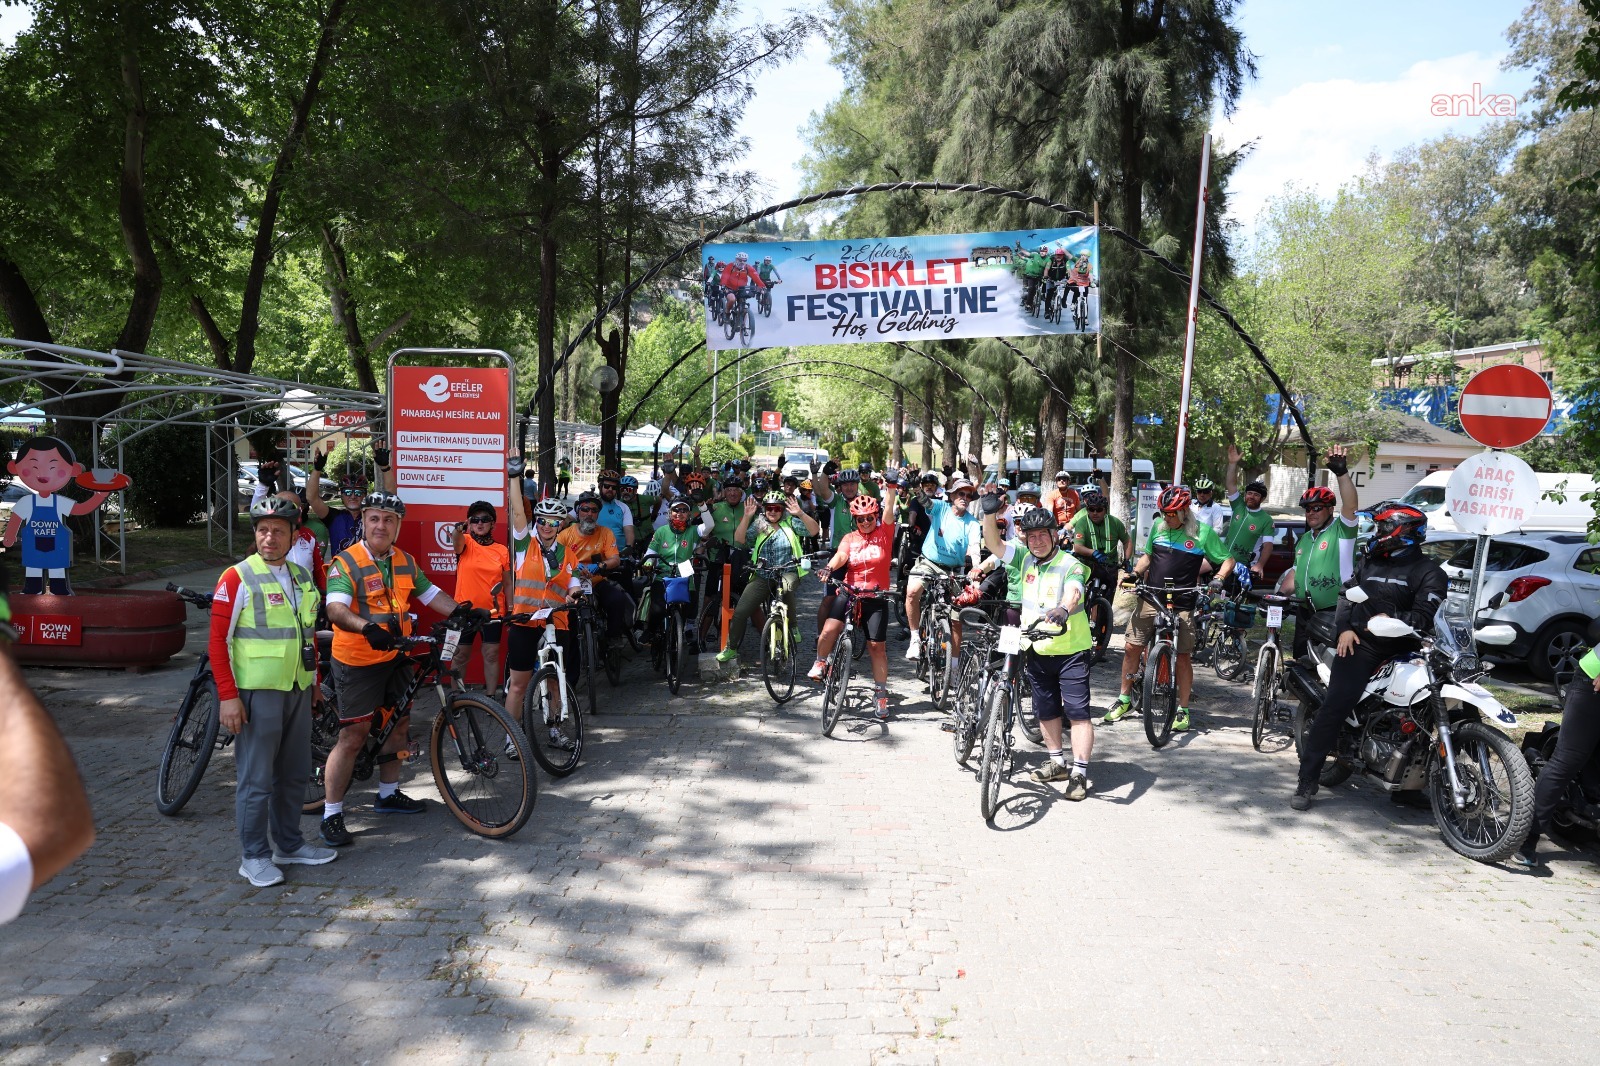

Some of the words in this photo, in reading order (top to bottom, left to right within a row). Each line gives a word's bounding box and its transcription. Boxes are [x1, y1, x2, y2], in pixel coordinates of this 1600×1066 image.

[815, 258, 968, 290] BİSİKLET
[832, 312, 869, 340] Hoş
[877, 310, 959, 334] Geldiniz
[450, 383, 483, 393] EFELER
[401, 409, 444, 420] PINARBAŞI
[445, 408, 476, 420] MESİRE
[477, 411, 500, 420] ALANI
[400, 433, 432, 443] OLİMPİK
[433, 435, 470, 447] TIRMANIŞ
[471, 436, 501, 446] DUVARI
[400, 454, 442, 464] PINARBAŞI
[443, 455, 463, 463] KAFE
[400, 473, 425, 481] DOWN
[426, 474, 445, 482] CAFE
[1474, 467, 1515, 484] ARAÇ
[1468, 484, 1514, 504] GİRİŞİ
[1452, 499, 1524, 521] YASAKTIR
[30, 520, 59, 528] DOWN
[33, 528, 56, 536] KAFE
[40, 623, 71, 632] DOWN
[42, 631, 67, 640] KAFE
